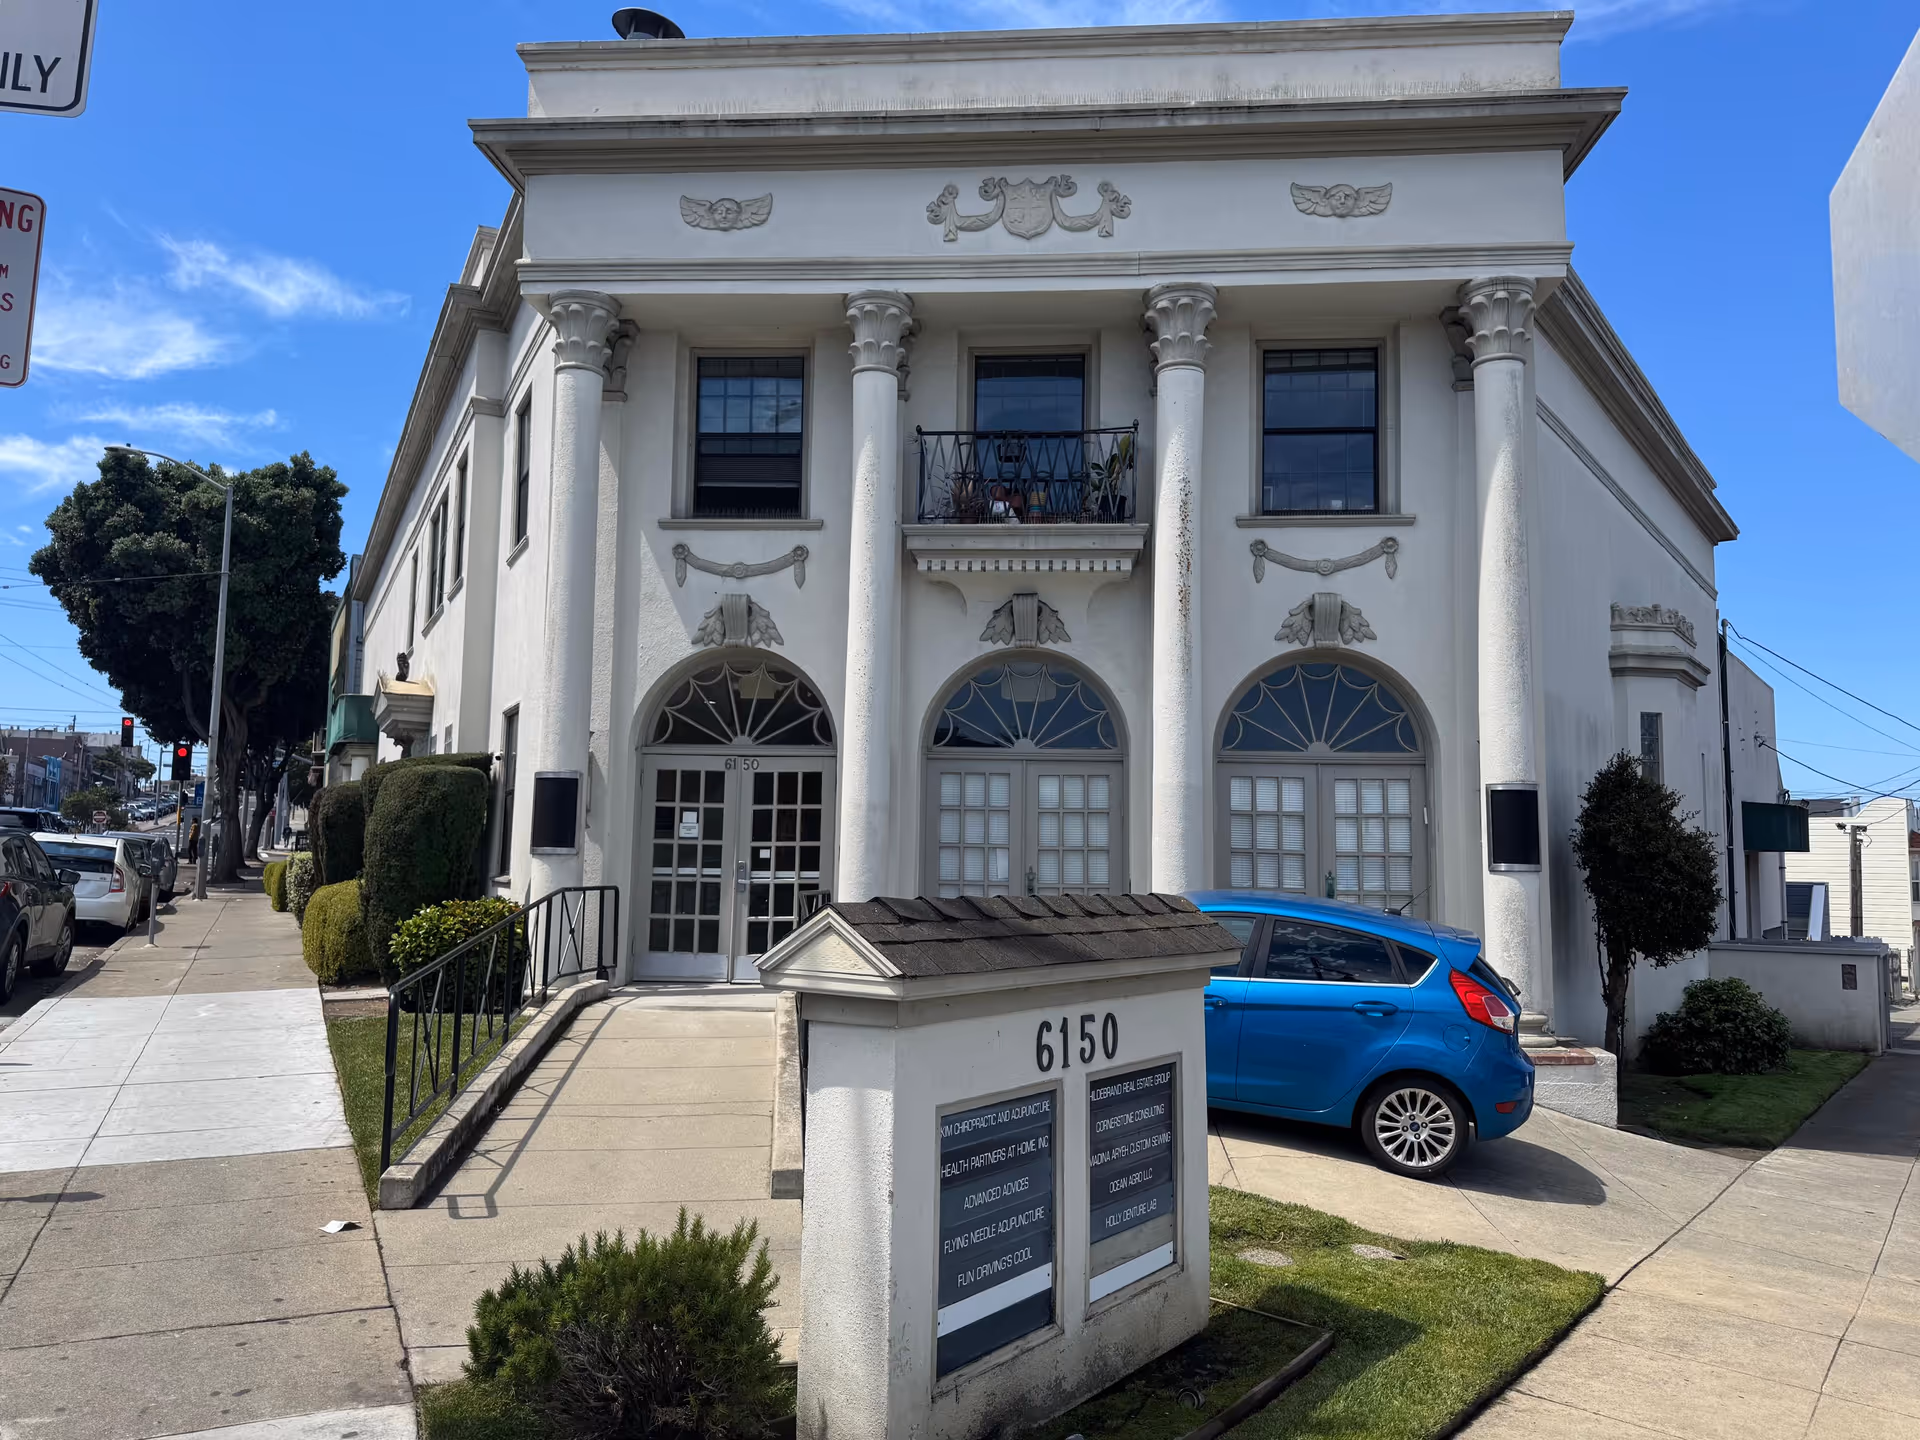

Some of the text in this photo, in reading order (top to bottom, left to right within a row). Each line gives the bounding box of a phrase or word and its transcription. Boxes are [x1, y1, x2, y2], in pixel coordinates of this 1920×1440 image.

[1036, 1012, 1118, 1072] 6150
[1123, 1080, 1136, 1093] REAL
[1137, 1075, 1153, 1090] ESTATE
[1154, 1071, 1171, 1085] GROUP
[940, 1100, 1050, 1138] KIM CHIROPRACTIC AND ACUPUNCTURE
[1095, 1103, 1165, 1133] CORNERSTONE CONSULTING
[941, 1158, 969, 1178] HEALTH
[970, 1147, 1006, 1170] PARTNERS
[1007, 1144, 1016, 1159] AT
[1111, 1145, 1129, 1160] ARYEH
[1129, 1137, 1151, 1154] CUSTOM
[1151, 1131, 1171, 1147] SEWING
[963, 1176, 1029, 1210] ADVANCED ADVICES
[1109, 1167, 1153, 1193] OCEAN AGRO LLC
[944, 1205, 1045, 1254] FLYING NEEDLE ACUPUNCTURE
[1105, 1198, 1157, 1228] HOLLY DENTURE LAB
[957, 1246, 1033, 1288] FUN DRIVING'S COOL
